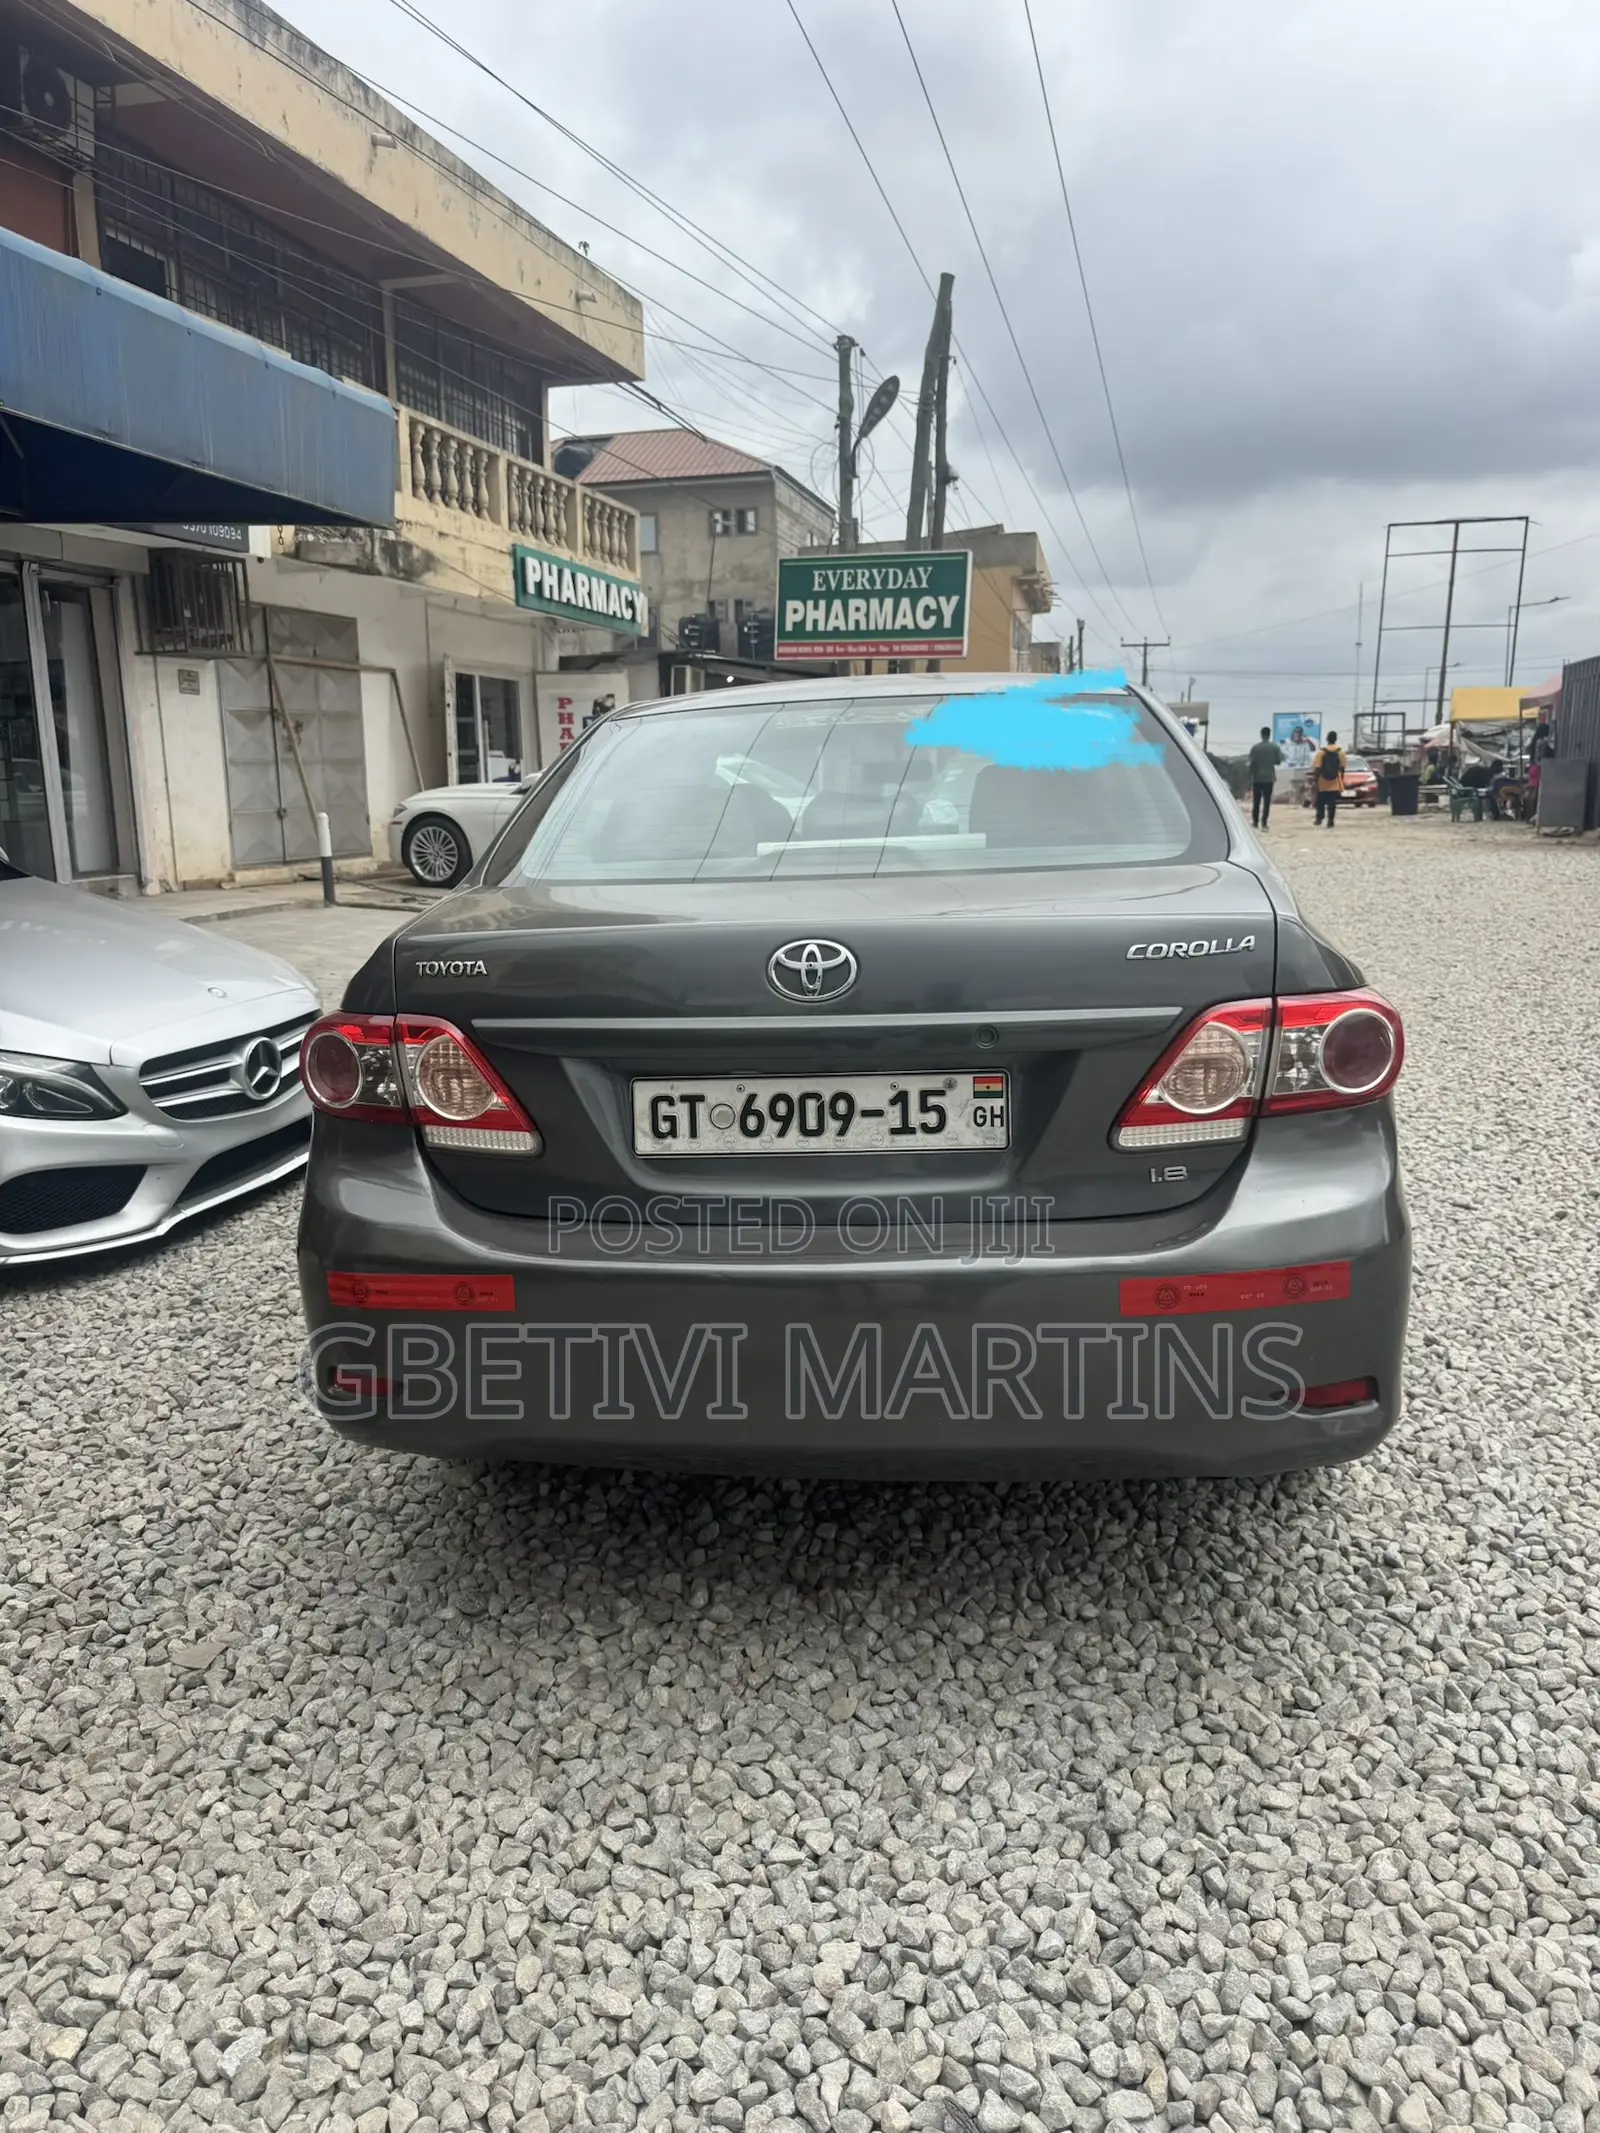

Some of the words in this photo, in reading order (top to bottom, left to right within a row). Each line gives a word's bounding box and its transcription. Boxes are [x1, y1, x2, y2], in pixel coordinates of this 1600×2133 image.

[525, 556, 645, 624] PHARMACY
[812, 567, 933, 592] EVERYDAY
[785, 596, 960, 632] PHARMACY
[1126, 935, 1256, 960] COROLLA
[416, 960, 488, 977] TOYOTA
[651, 1094, 705, 1138] GT
[740, 1090, 946, 1138] 6909-15
[973, 1106, 1004, 1127] GH
[1150, 1166, 1188, 1183] 1.8
